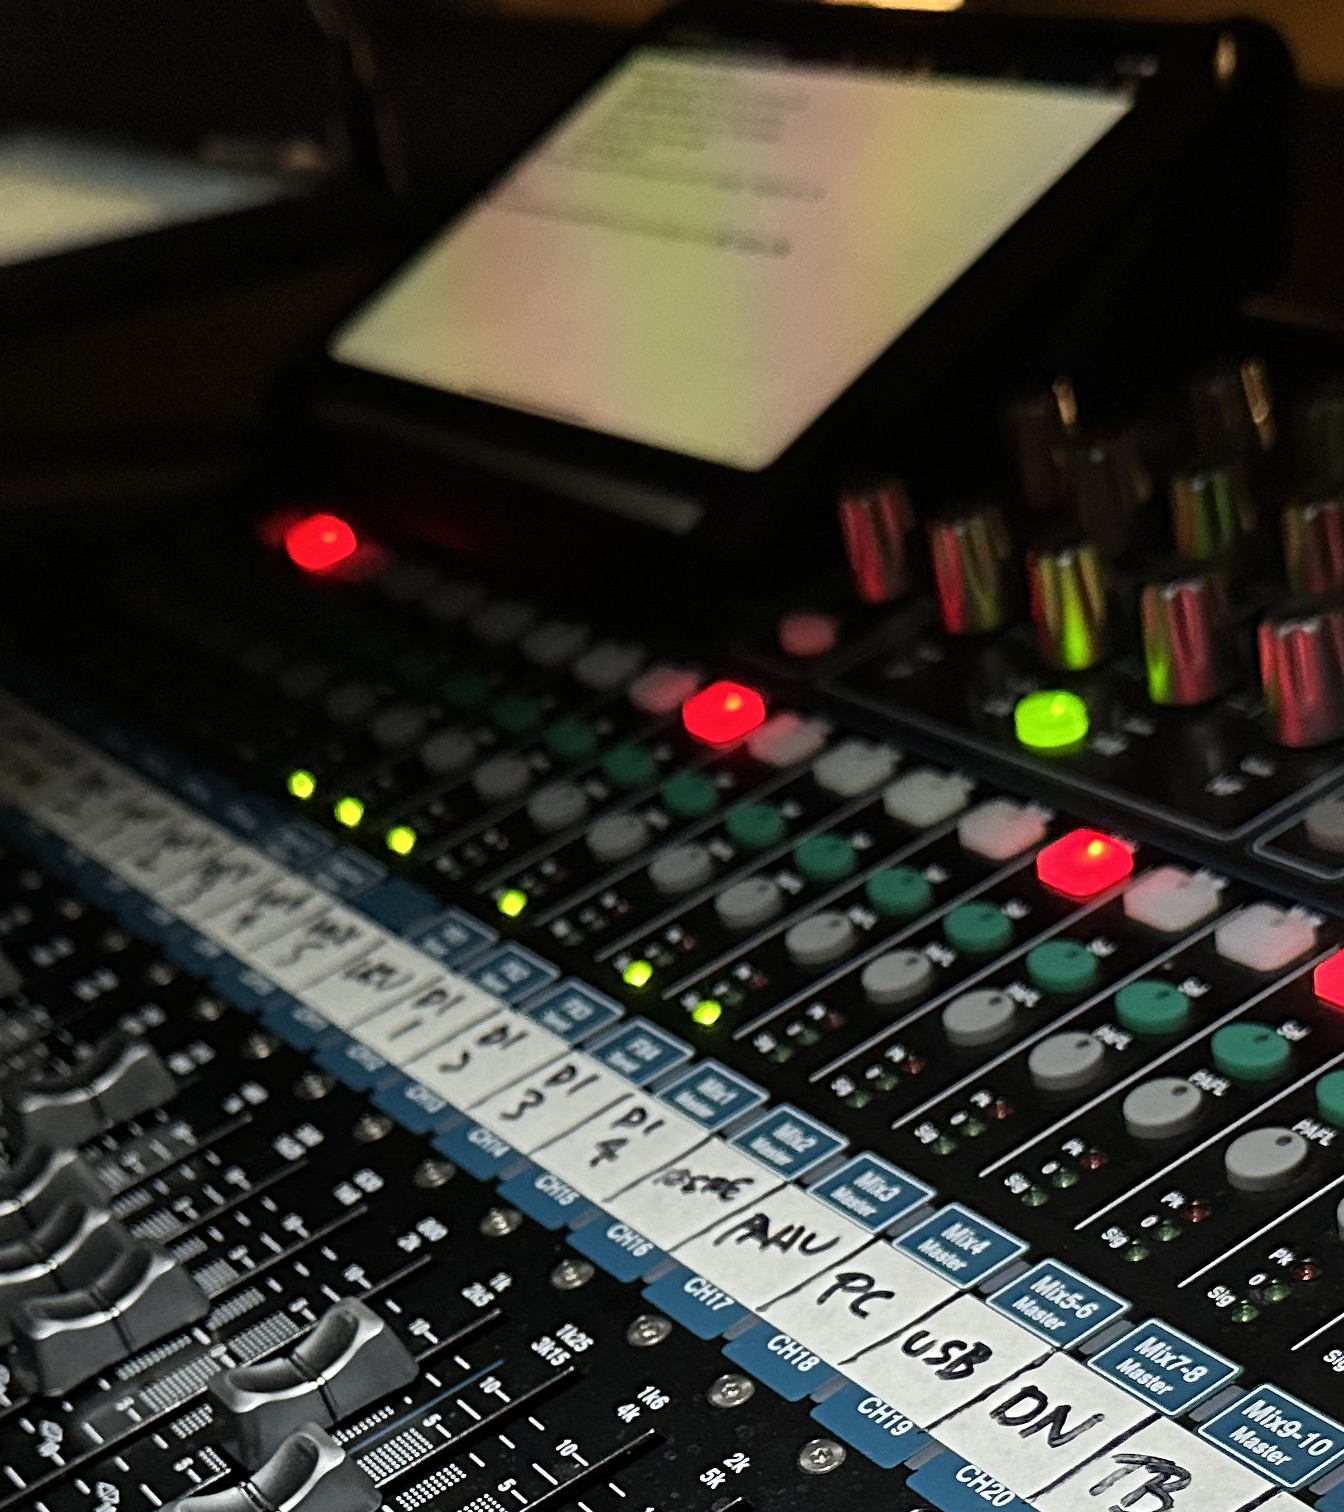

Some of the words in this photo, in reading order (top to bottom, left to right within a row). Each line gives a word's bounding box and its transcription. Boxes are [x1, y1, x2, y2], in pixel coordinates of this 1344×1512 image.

[588, 1136, 630, 1168] 4
[683, 1276, 737, 1313] CH17
[816, 1271, 897, 1321] PC
[1011, 1294, 1067, 1333] Master
[1029, 1273, 1101, 1320] Mix5-6
[764, 1333, 822, 1374] CH18
[900, 1329, 993, 1382] USB
[1133, 1336, 1212, 1384] Mix7-8
[1114, 1358, 1175, 1398] Master
[616, 1401, 642, 1424] 4k
[636, 1386, 671, 1411] 1k6
[856, 1396, 914, 1438] CH19
[989, 1384, 1106, 1450] DN
[555, 1437, 579, 1458] 10
[1228, 1425, 1293, 1469] Master
[1241, 1398, 1334, 1458] Mix9-10
[698, 1467, 728, 1490] 5k
[722, 1451, 752, 1475] 2k
[497, 1477, 517, 1493] 5
[955, 1464, 1017, 1508] CH20
